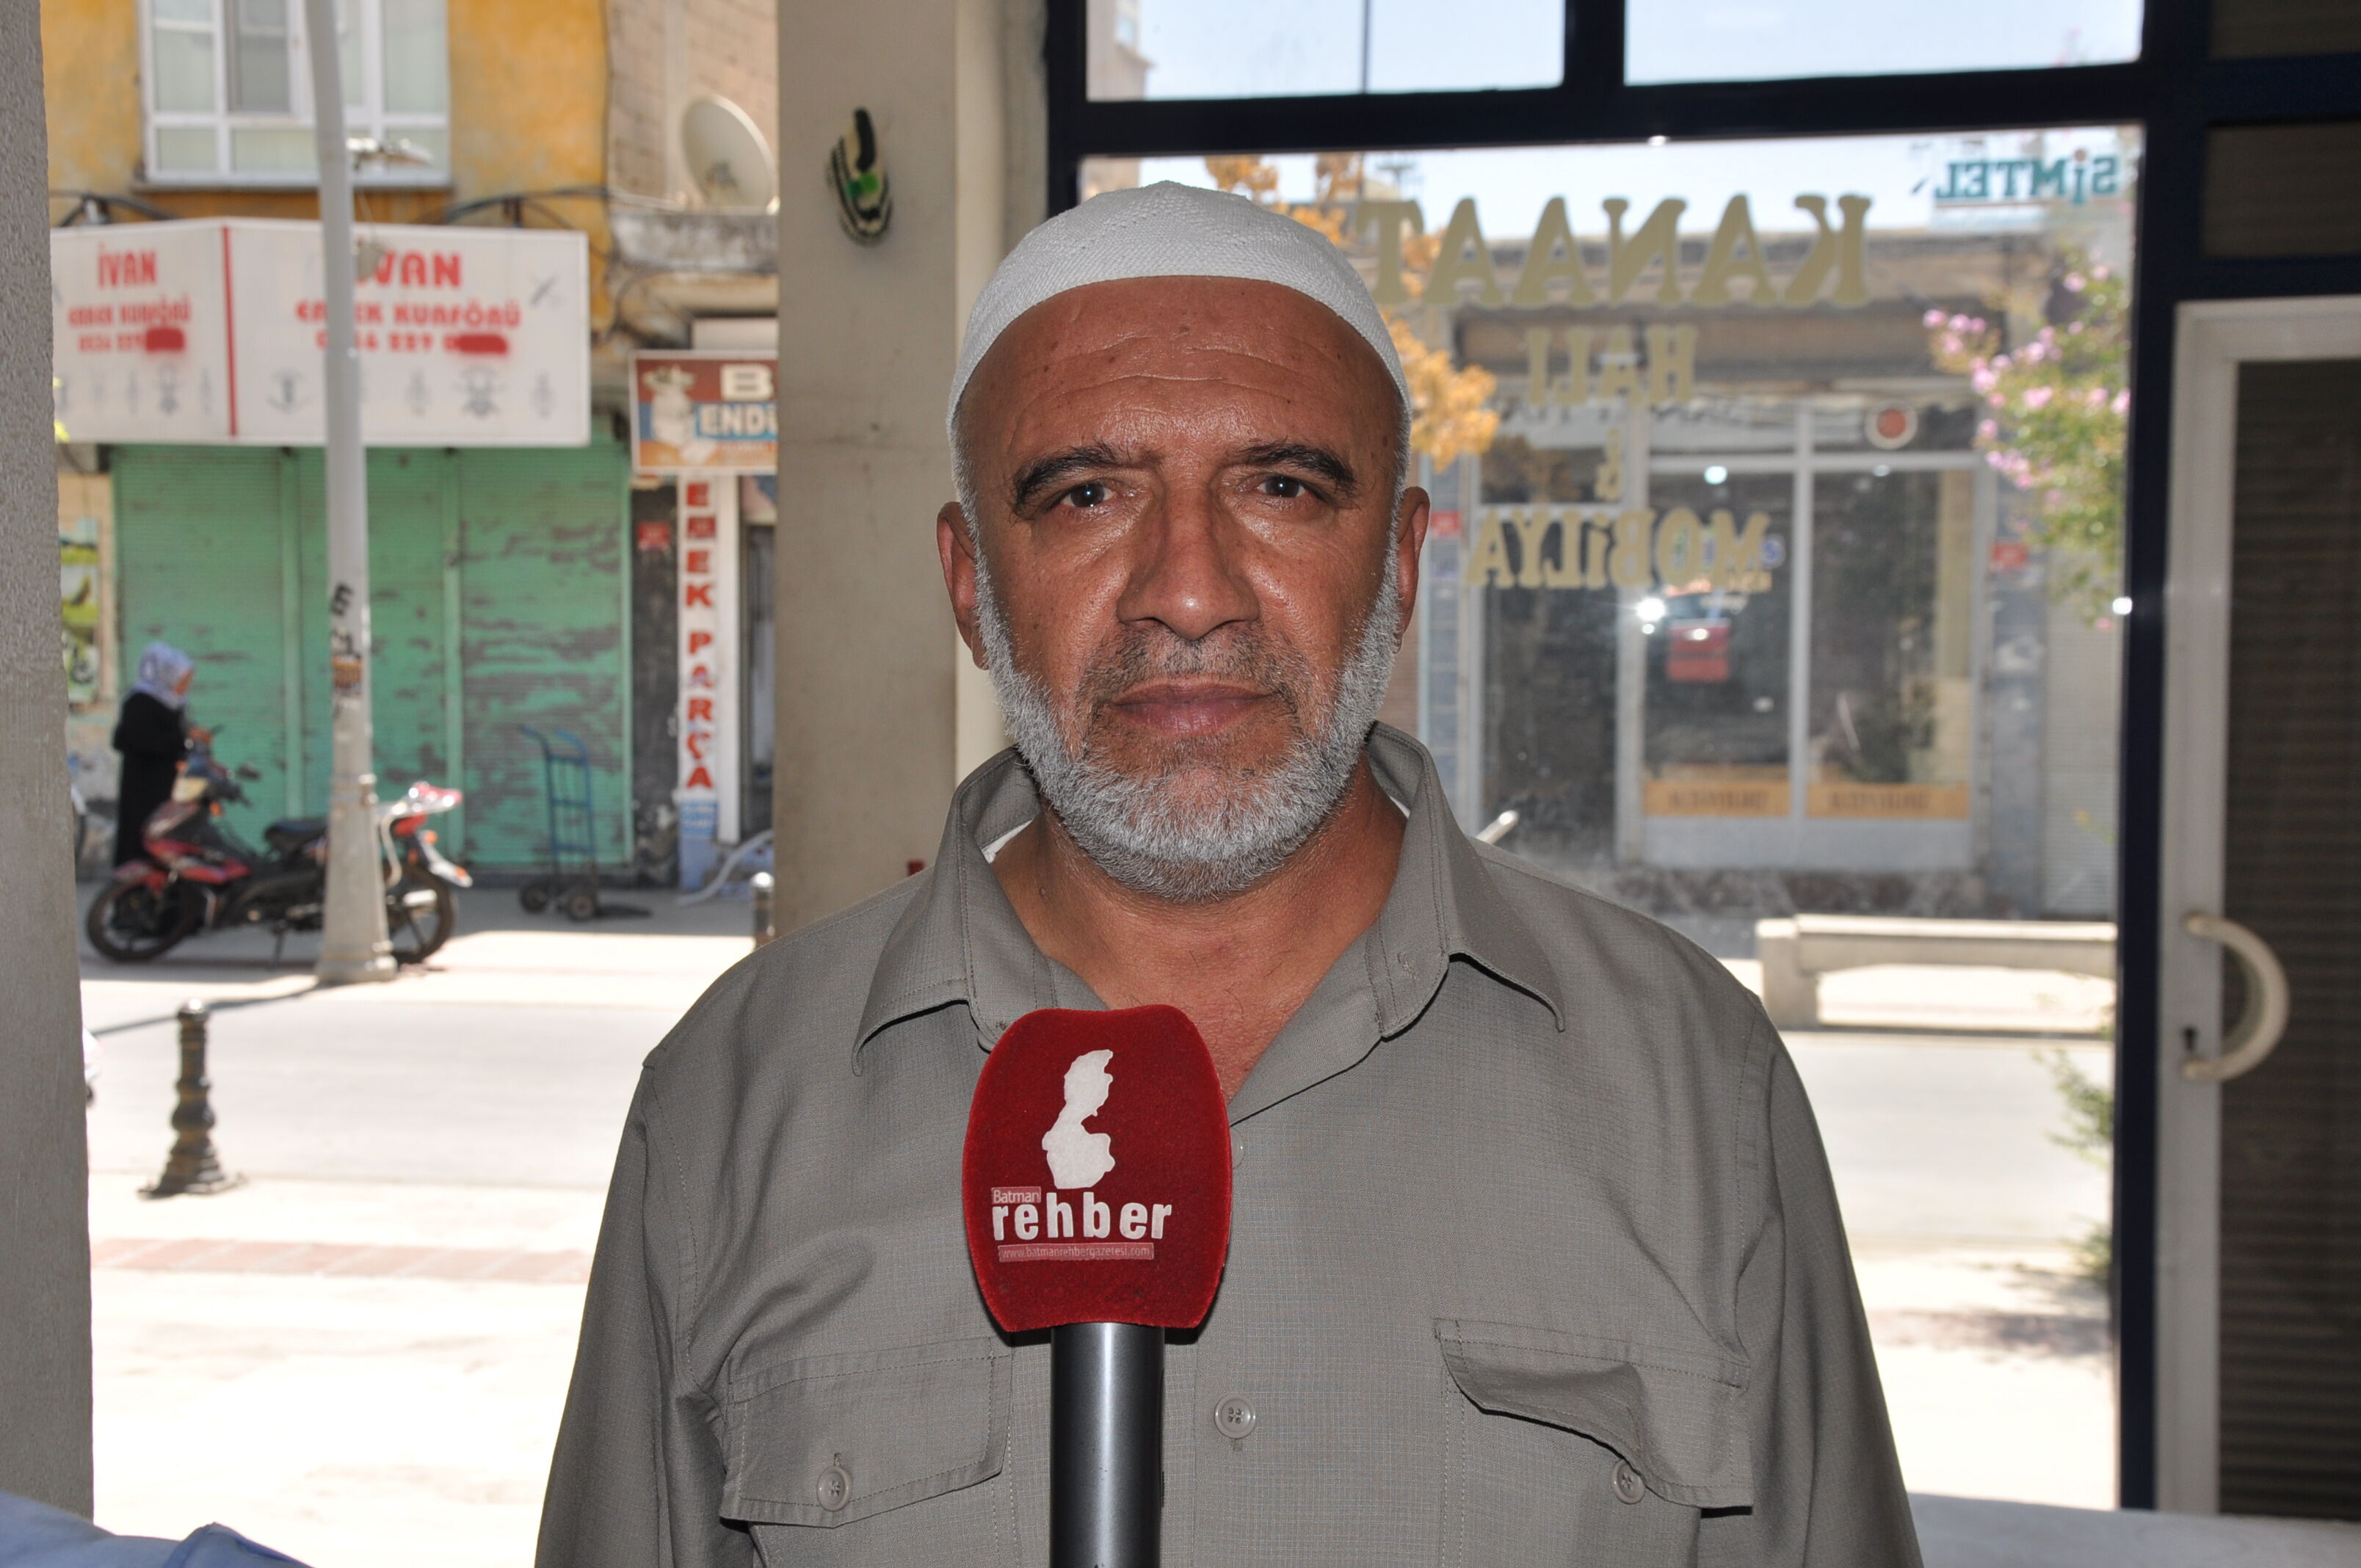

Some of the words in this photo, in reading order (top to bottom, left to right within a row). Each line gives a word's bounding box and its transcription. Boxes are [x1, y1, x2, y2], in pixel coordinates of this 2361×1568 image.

[686, 482, 717, 609] EEK
[993, 1188, 1040, 1203] Batman
[992, 1191, 1172, 1241] rehber
[1001, 1246, 1150, 1260] www.batmanrehbergazetesi.com
